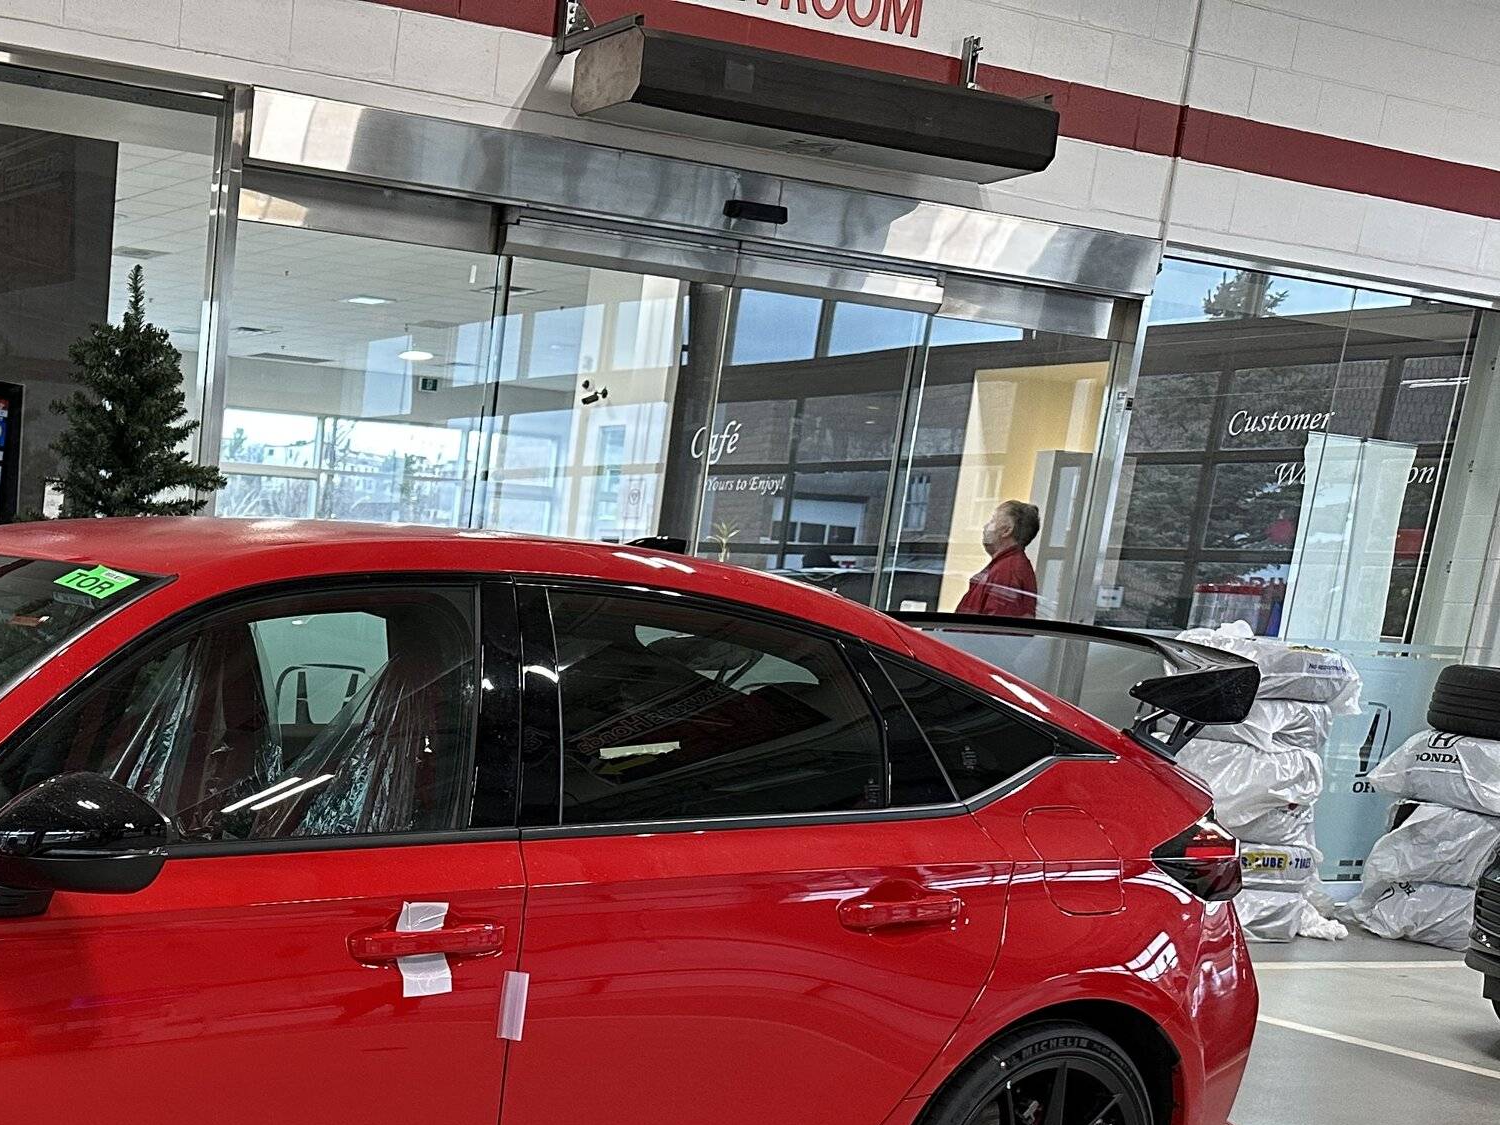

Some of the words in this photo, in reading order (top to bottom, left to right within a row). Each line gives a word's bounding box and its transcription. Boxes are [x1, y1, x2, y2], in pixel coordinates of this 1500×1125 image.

[1228, 409, 1336, 437] Customer
[706, 476, 735, 492] Yours
[735, 479, 748, 491] to
[748, 476, 787, 496] Enjoy!
[65, 572, 115, 595] TOR
